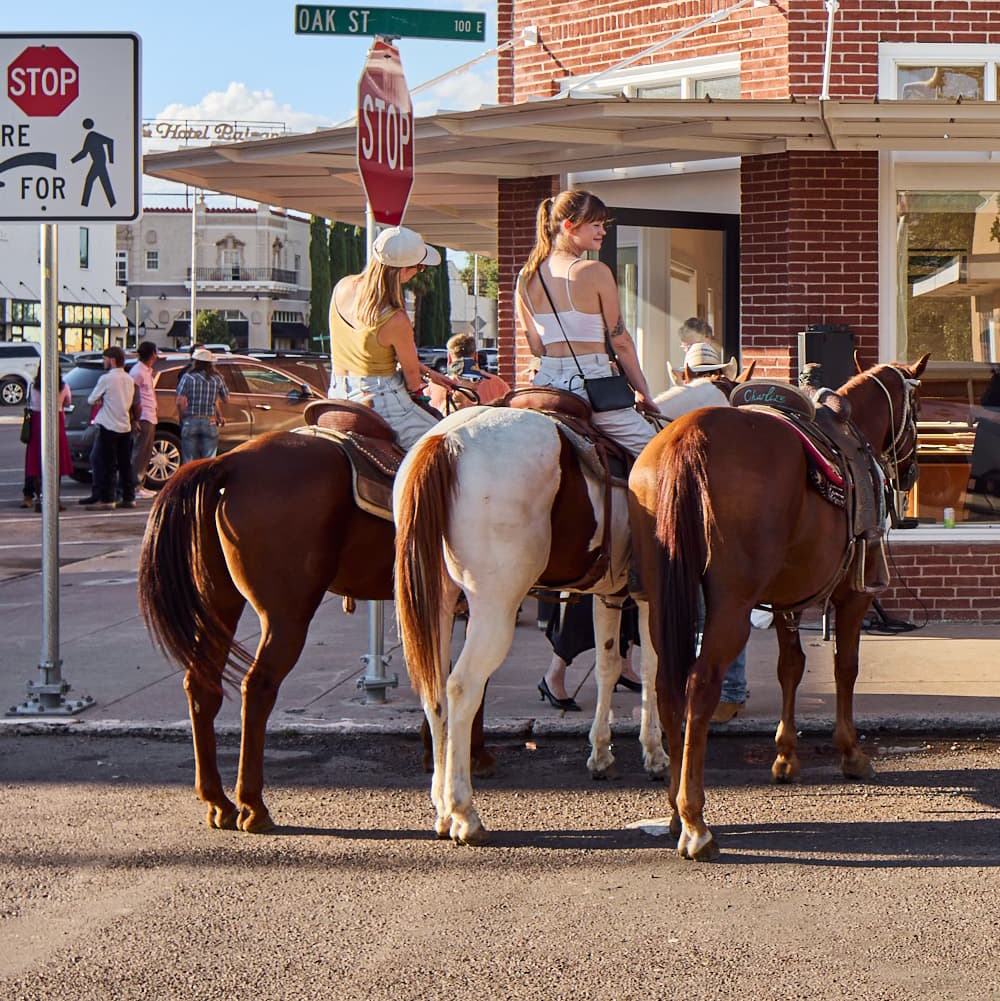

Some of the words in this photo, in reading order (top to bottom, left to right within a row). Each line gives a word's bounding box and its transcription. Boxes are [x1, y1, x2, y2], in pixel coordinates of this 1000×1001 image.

[299, 8, 337, 32] OAK
[348, 10, 371, 33] ST
[453, 19, 472, 33] 100
[476, 20, 483, 33] E
[9, 67, 77, 96] STOP
[1, 124, 31, 147] RE
[156, 122, 210, 140] Hotel
[361, 93, 411, 171] STOP
[21, 176, 66, 200] FOR
